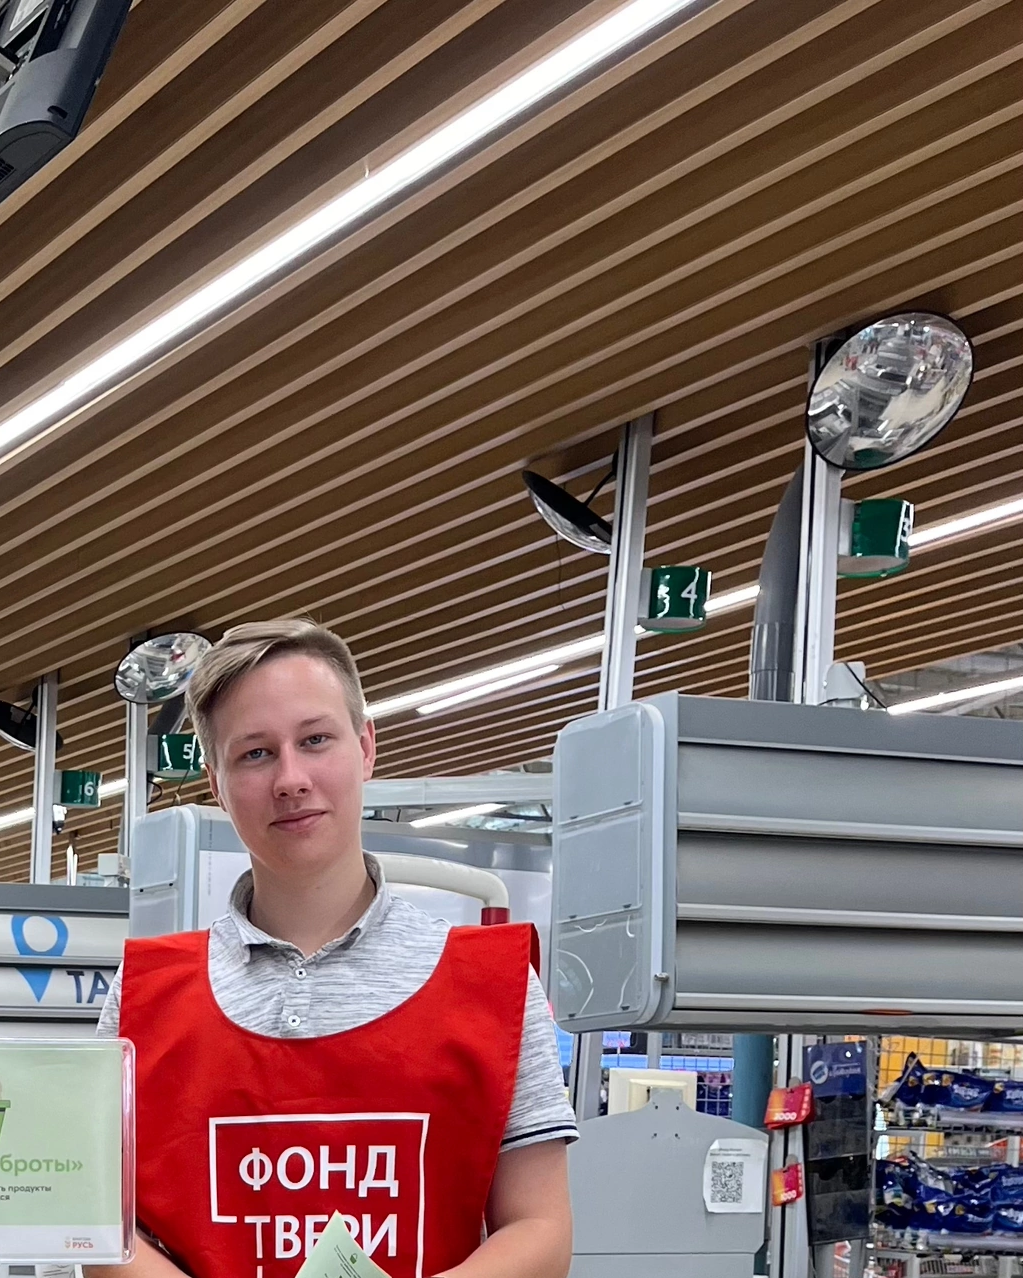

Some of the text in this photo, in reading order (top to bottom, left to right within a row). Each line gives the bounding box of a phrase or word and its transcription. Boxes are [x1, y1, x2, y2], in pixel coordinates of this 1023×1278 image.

[183, 743, 192, 760] 5
[84, 781, 94, 797] 6
[239, 1145, 399, 1198] ФОНД
[8, 1185, 52, 1193] продукты
